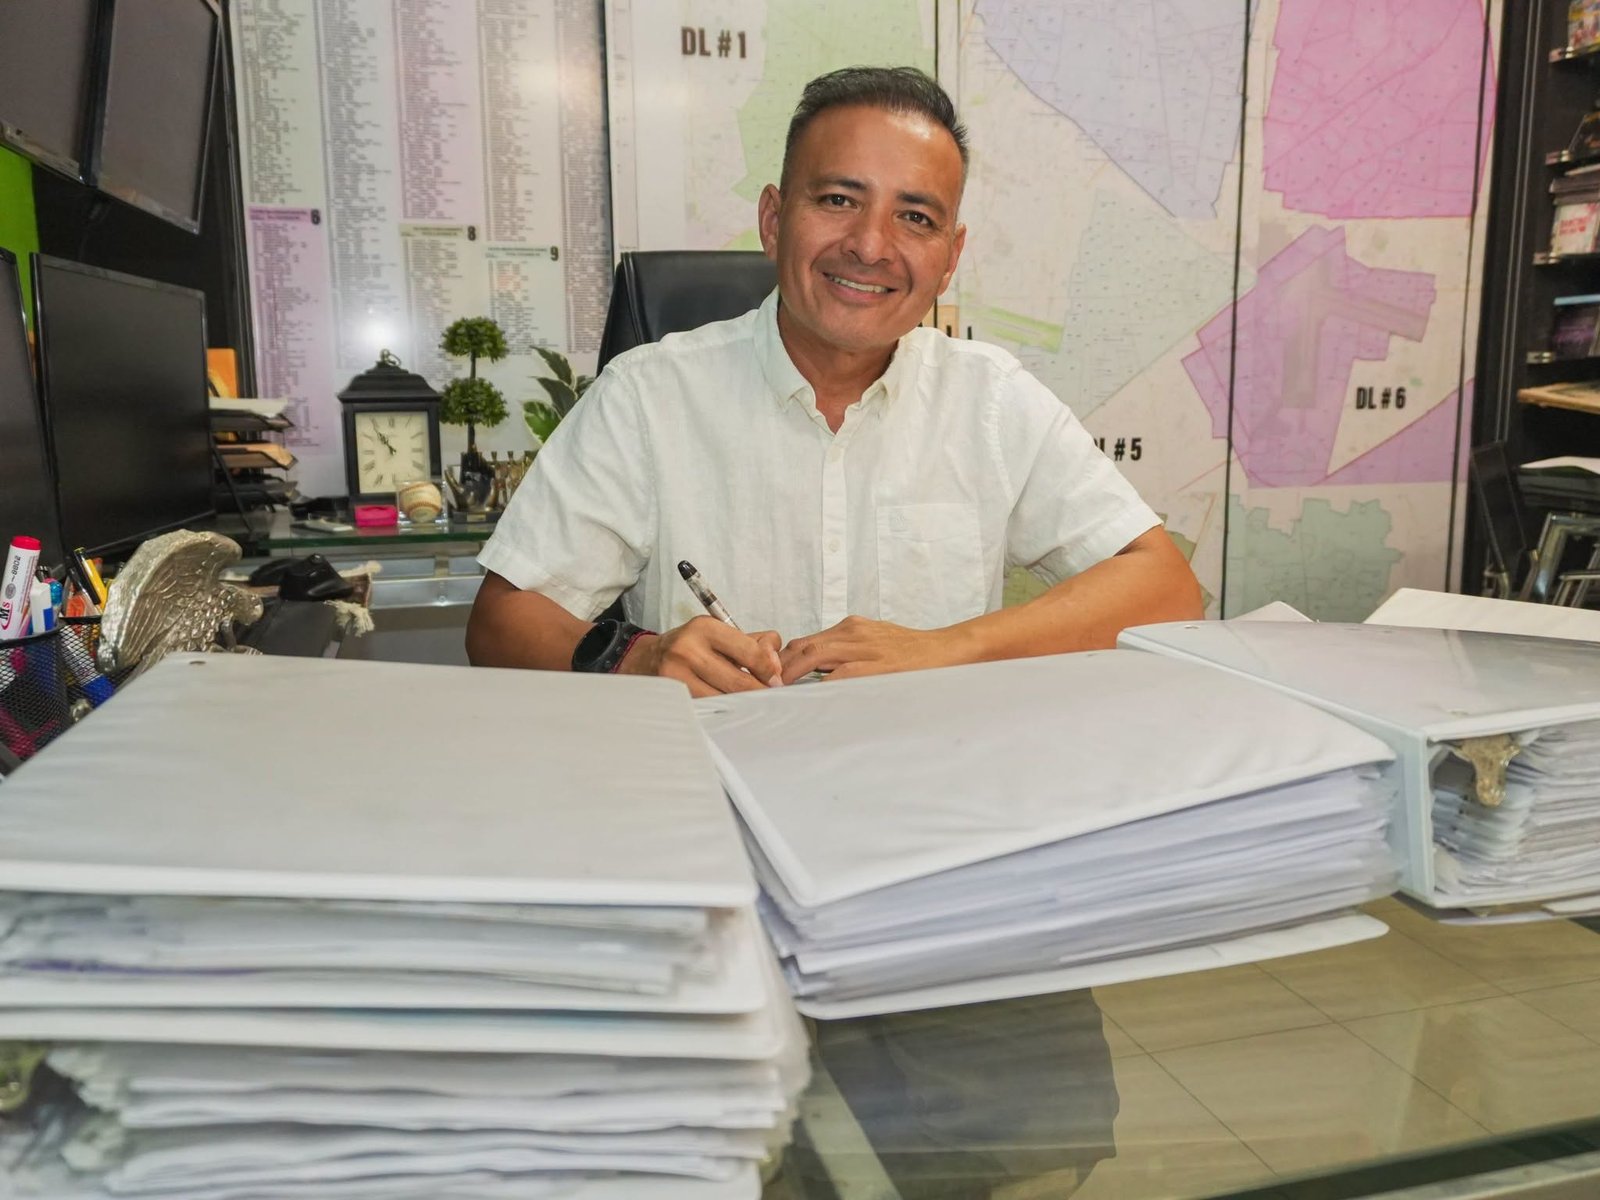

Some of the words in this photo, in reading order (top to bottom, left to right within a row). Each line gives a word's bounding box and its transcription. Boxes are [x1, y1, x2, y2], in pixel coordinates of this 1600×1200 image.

[310, 208, 321, 226] 6
[467, 225, 477, 241] 8
[550, 246, 559, 261] 9
